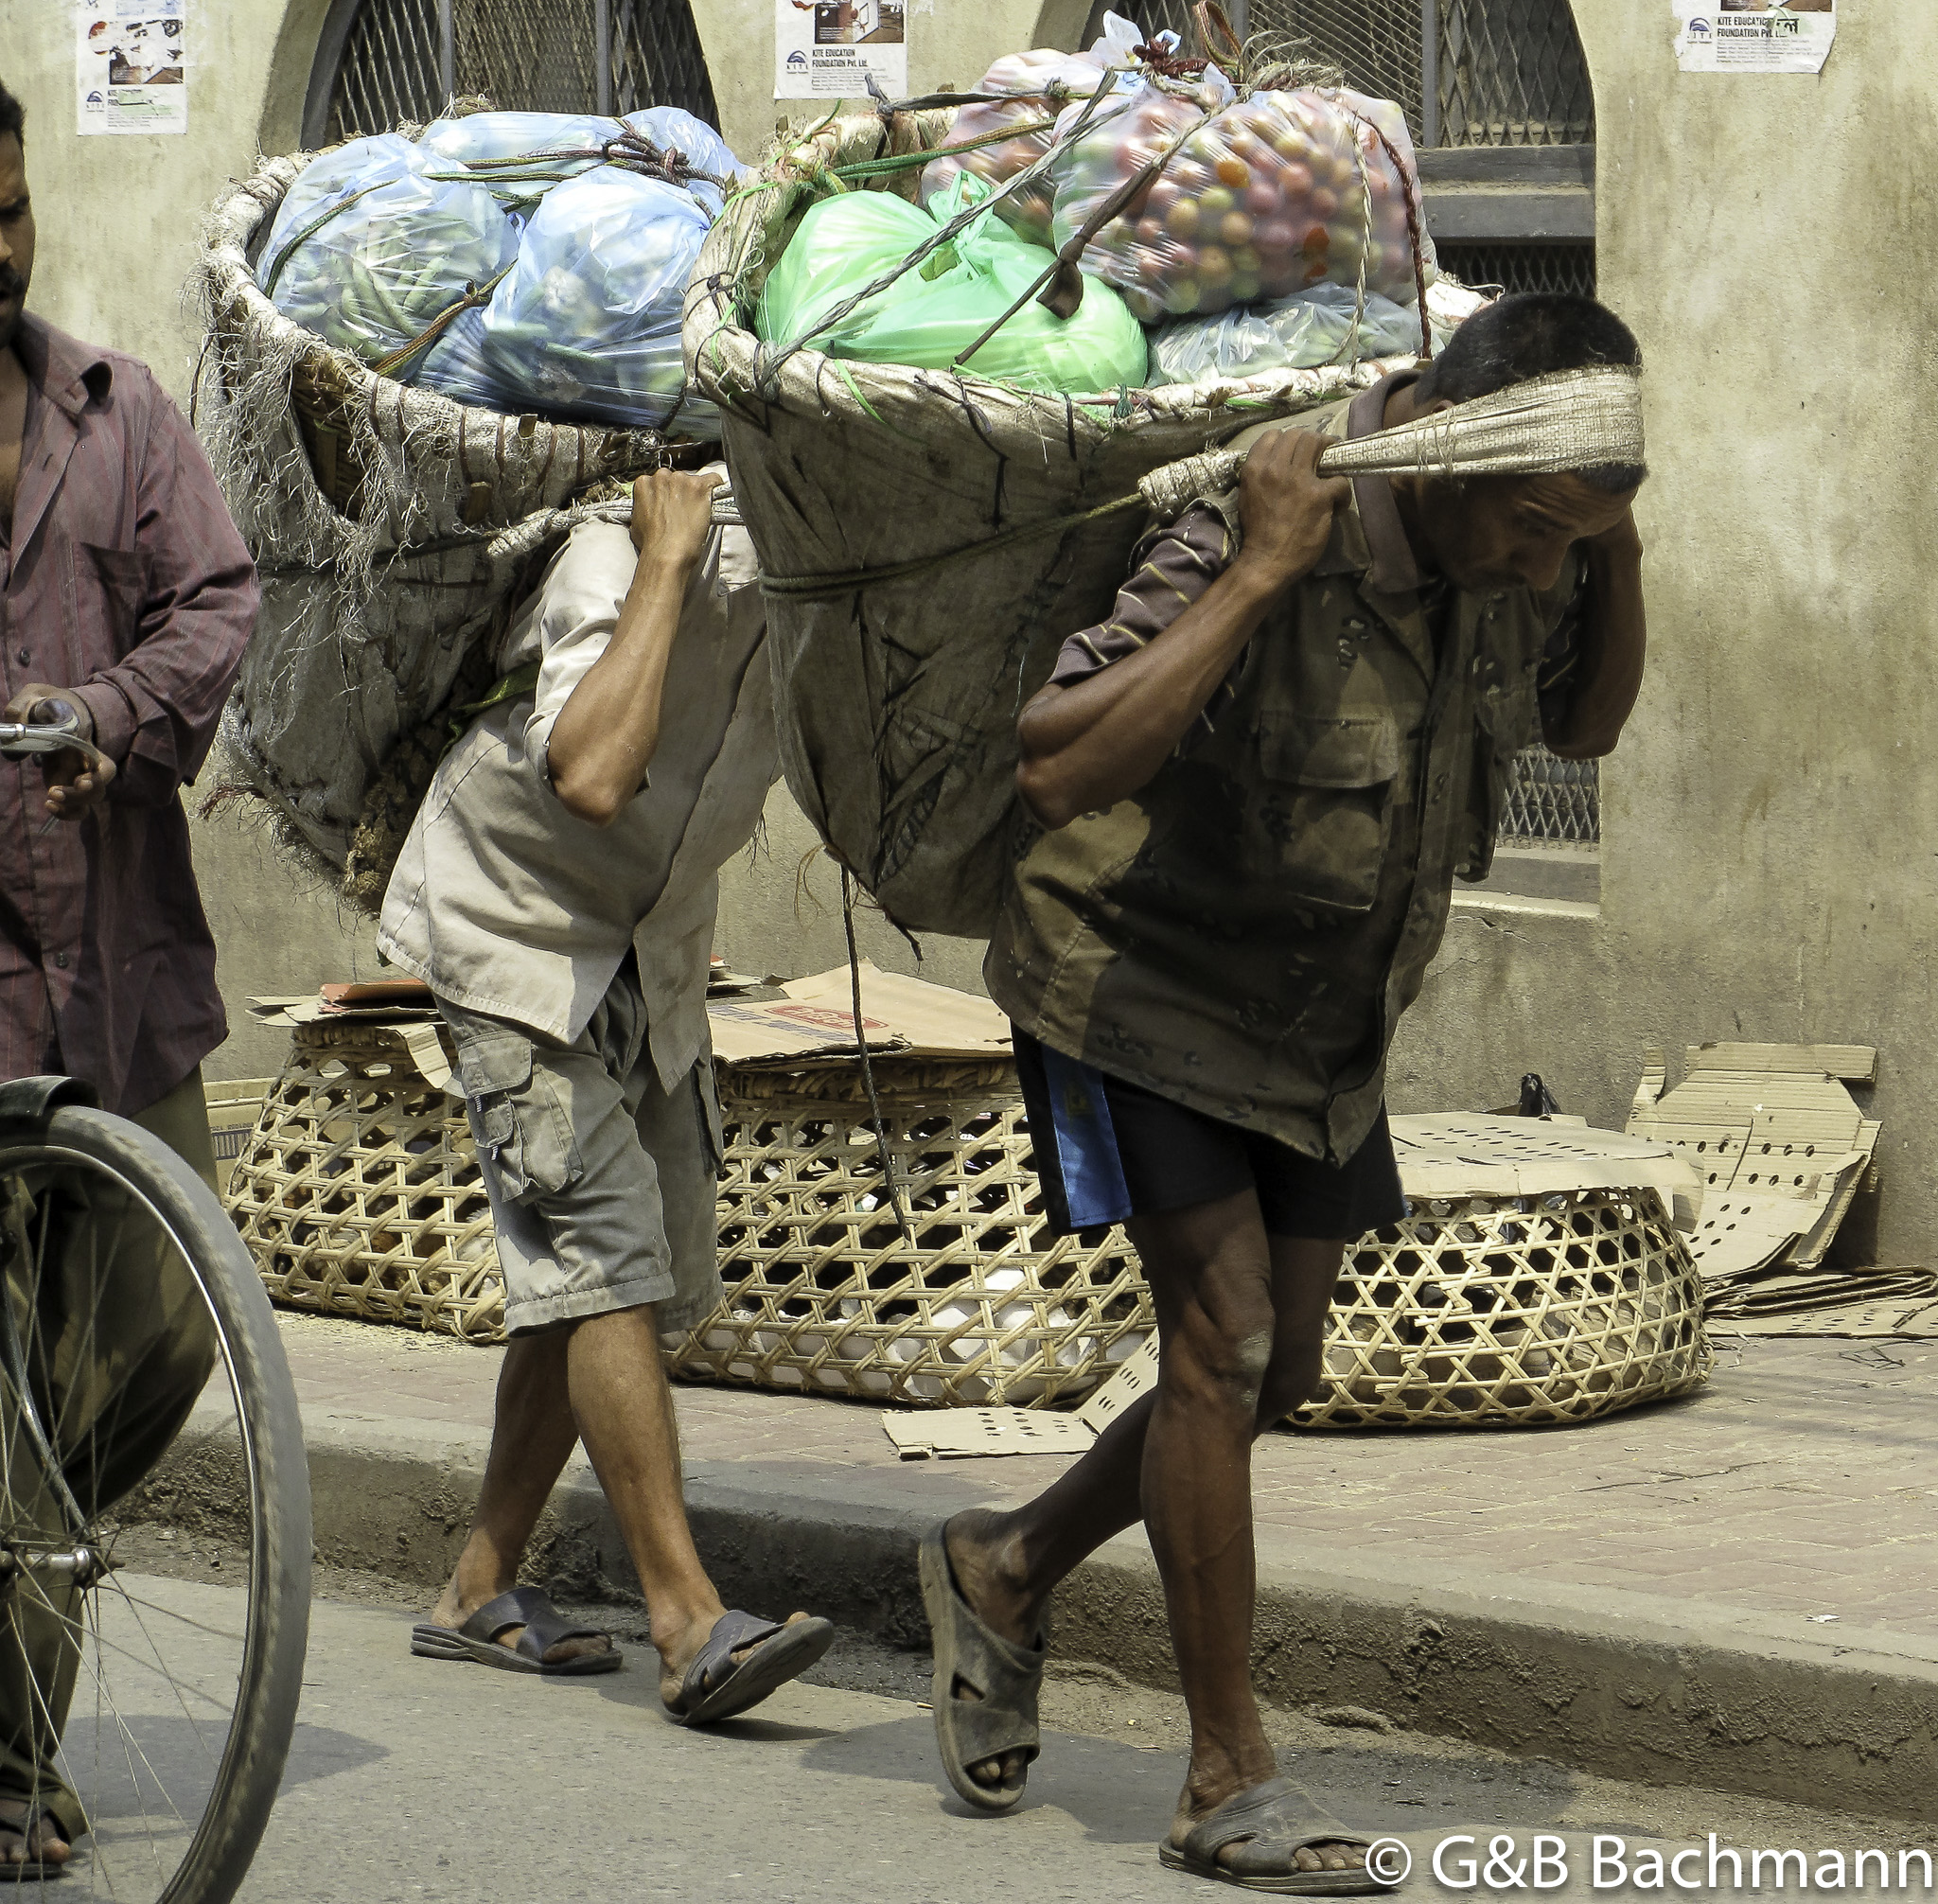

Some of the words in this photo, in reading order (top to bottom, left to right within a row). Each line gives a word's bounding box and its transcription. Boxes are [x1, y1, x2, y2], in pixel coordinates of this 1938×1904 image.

[1718, 17, 1732, 26] KITE
[1718, 28, 1760, 38] FOUNDATION
[812, 48, 823, 57] KITE
[825, 48, 855, 57] EDUCATION
[812, 59, 846, 67] FOUNDATION
